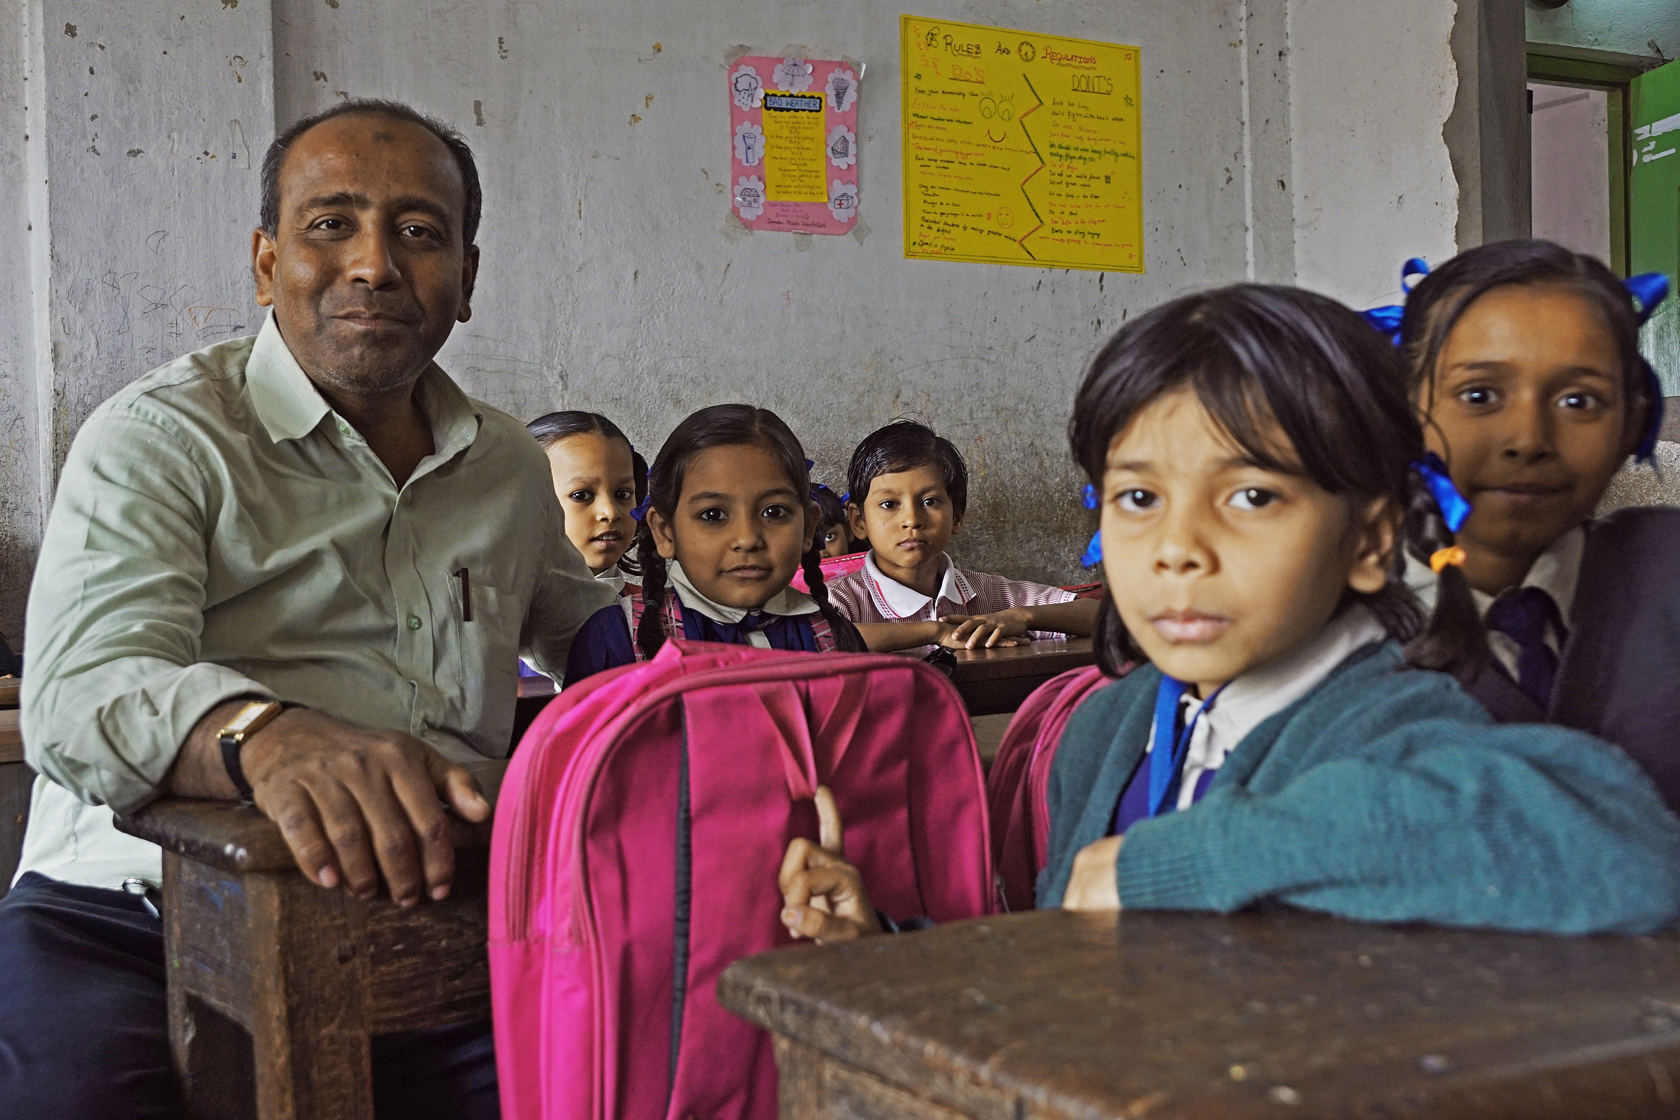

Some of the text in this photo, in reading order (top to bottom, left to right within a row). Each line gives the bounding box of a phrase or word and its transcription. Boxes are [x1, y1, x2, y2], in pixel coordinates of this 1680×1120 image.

[942, 34, 981, 57] RULES
[768, 97, 818, 109] BAD WEATHER
